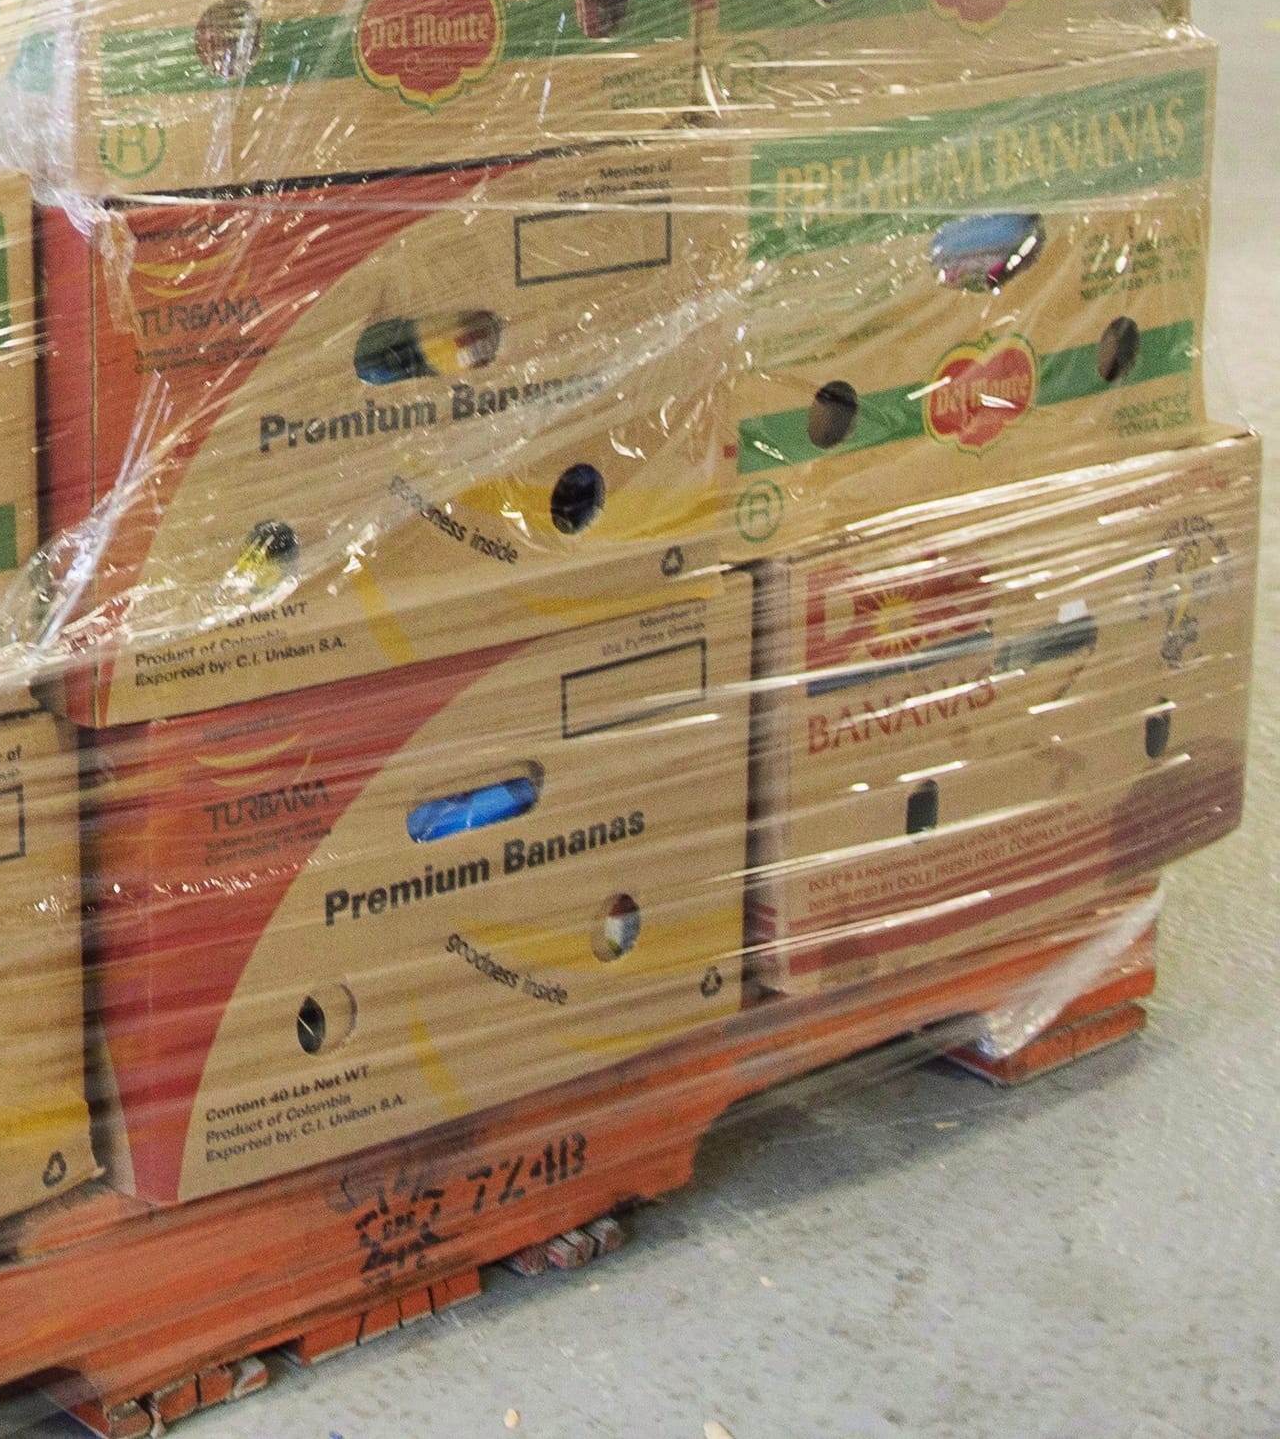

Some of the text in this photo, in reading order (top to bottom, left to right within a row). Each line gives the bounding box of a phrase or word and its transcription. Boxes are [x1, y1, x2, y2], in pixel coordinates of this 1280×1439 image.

[367, 14, 489, 50] Del Monte
[775, 97, 1184, 227] PREMIUM BANANAS
[138, 295, 263, 338] TURBANA
[260, 400, 437, 453] Premium
[470, 529, 518, 564] inside
[282, 602, 307, 619] WT
[135, 647, 195, 668] Product
[135, 663, 205, 688] Exported
[6, 743, 23, 762] of
[203, 779, 329, 833] TURBANA
[325, 811, 646, 926] Premium Bananas
[445, 933, 569, 1005] goodness inside
[205, 1097, 267, 1123] Content
[343, 1065, 369, 1082] WT
[205, 1093, 351, 1144] Product of Colombia
[205, 1134, 272, 1162] Exported
[329, 1105, 377, 1127] Uniban
